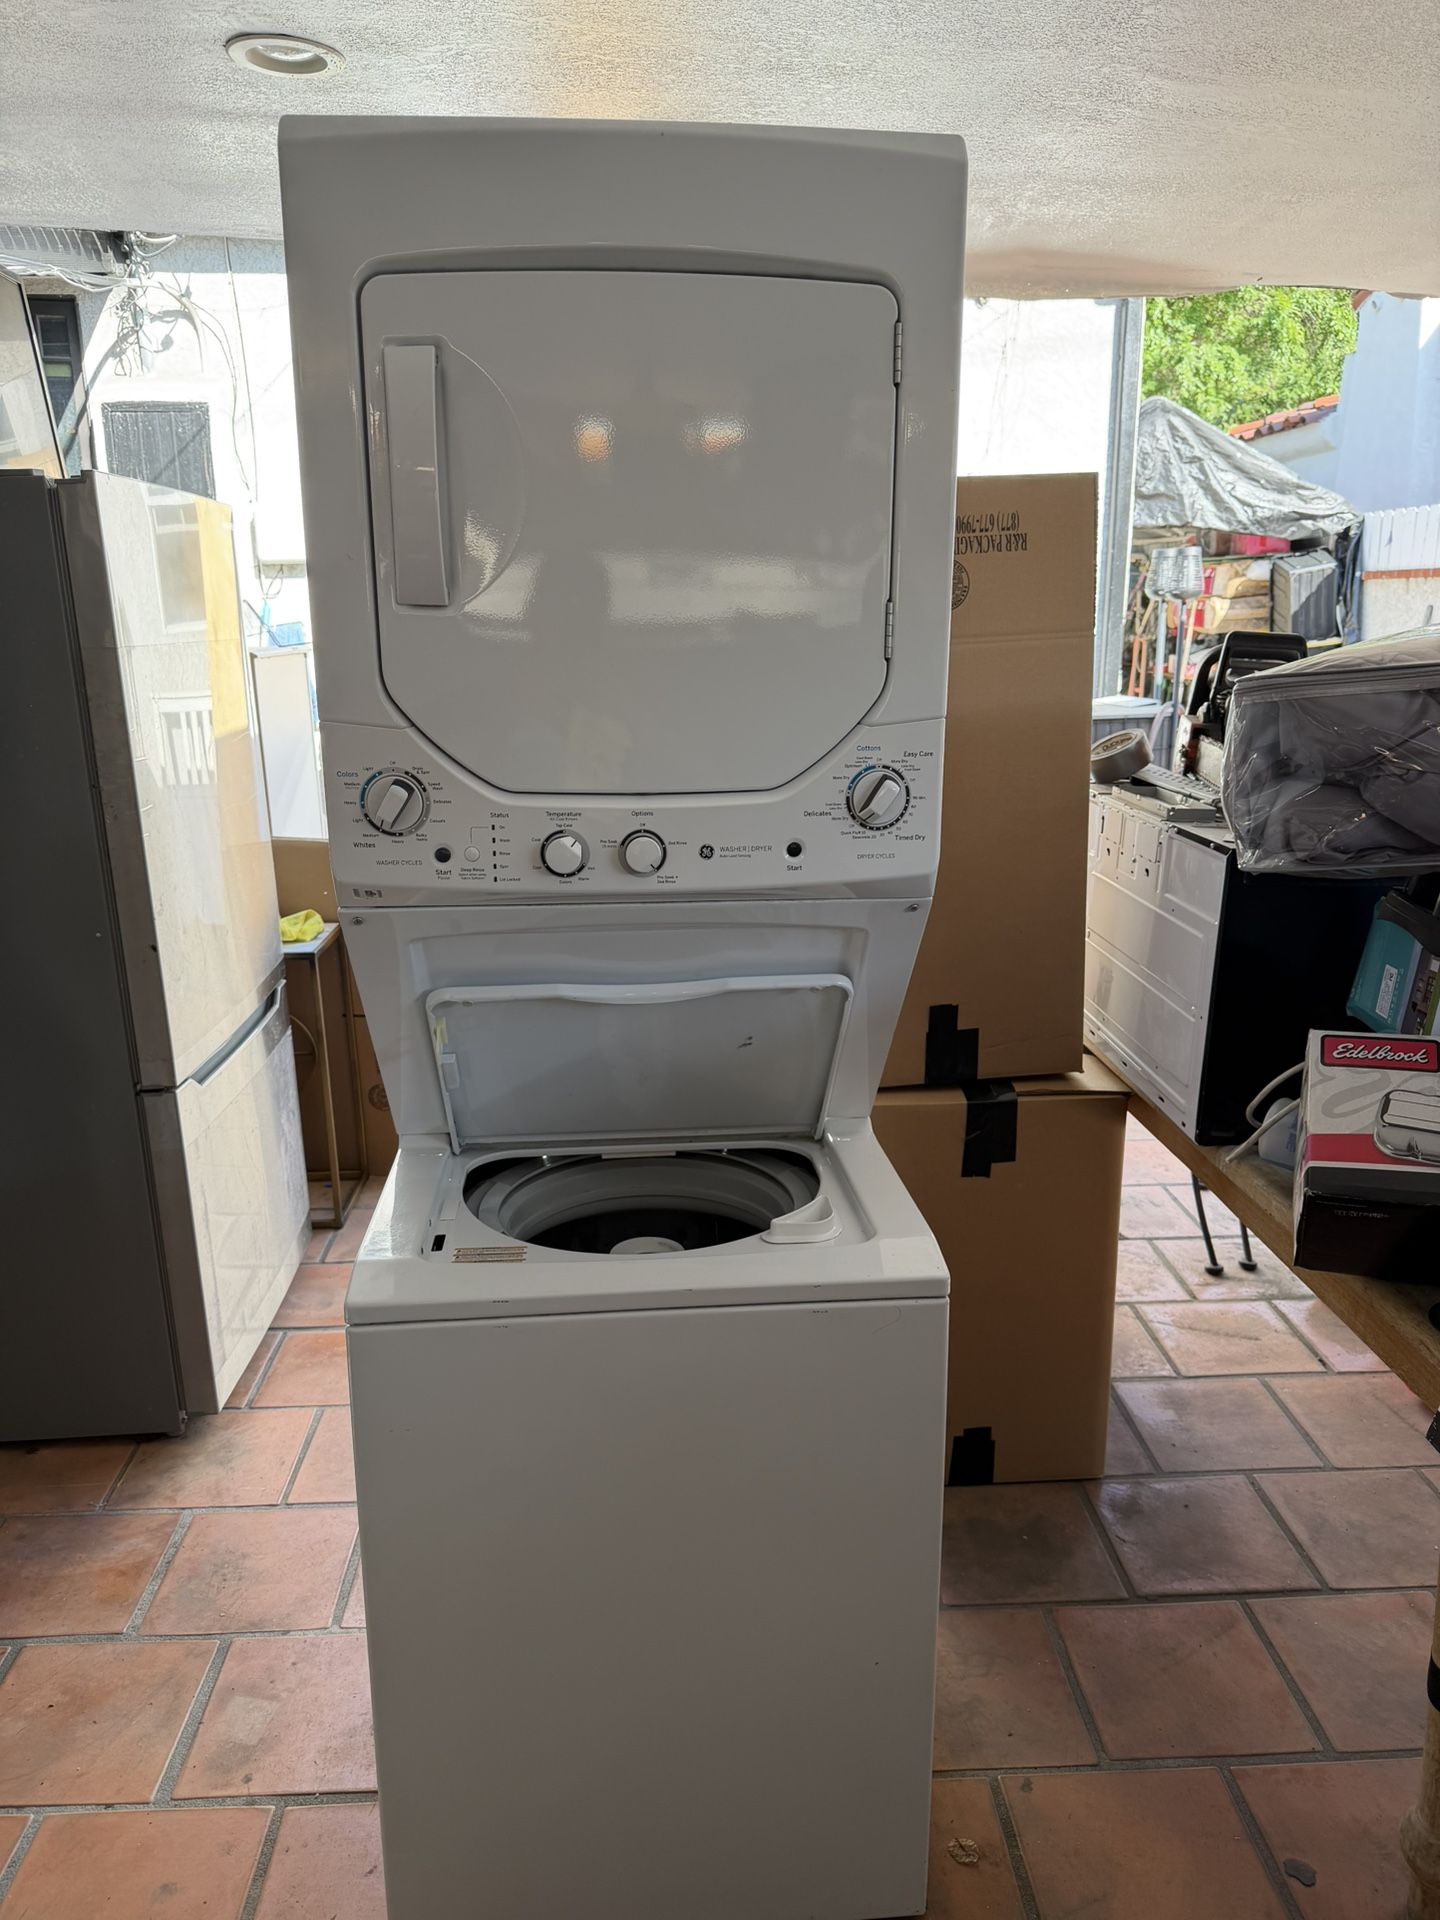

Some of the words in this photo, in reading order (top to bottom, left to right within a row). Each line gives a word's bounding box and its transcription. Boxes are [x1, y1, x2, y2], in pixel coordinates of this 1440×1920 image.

[956, 513, 995, 534] 677-7990
[996, 510, 1020, 533] (877)
[955, 534, 1002, 555] PACKAGI
[1004, 533, 1027, 552] R&R
[1332, 1042, 1429, 1064] Edelbrock
